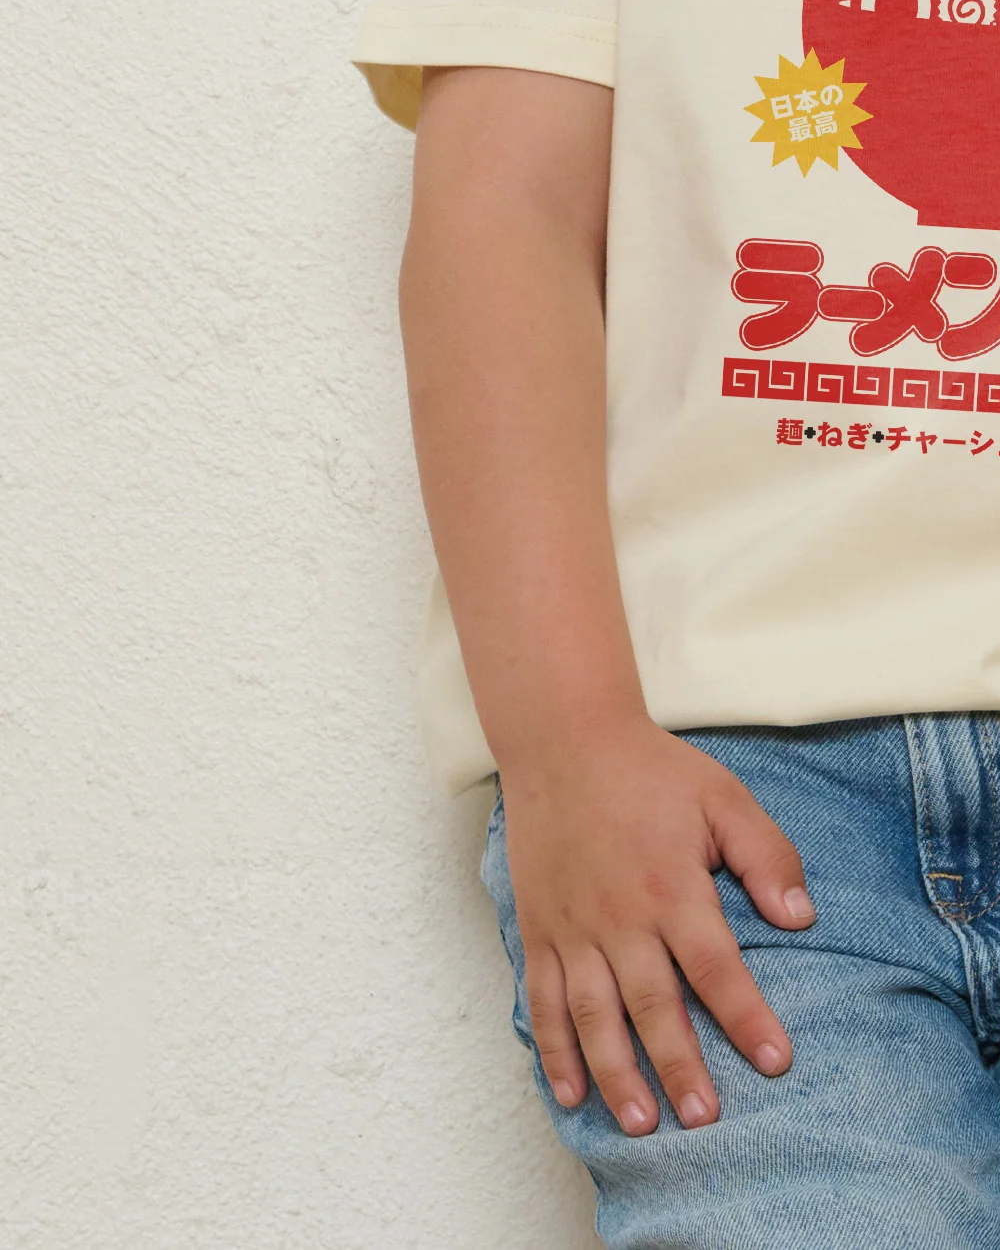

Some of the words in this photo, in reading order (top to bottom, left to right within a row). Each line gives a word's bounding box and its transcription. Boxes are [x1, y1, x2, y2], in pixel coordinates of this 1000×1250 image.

[769, 84, 844, 120] 日本の
[787, 110, 838, 143] 最高
